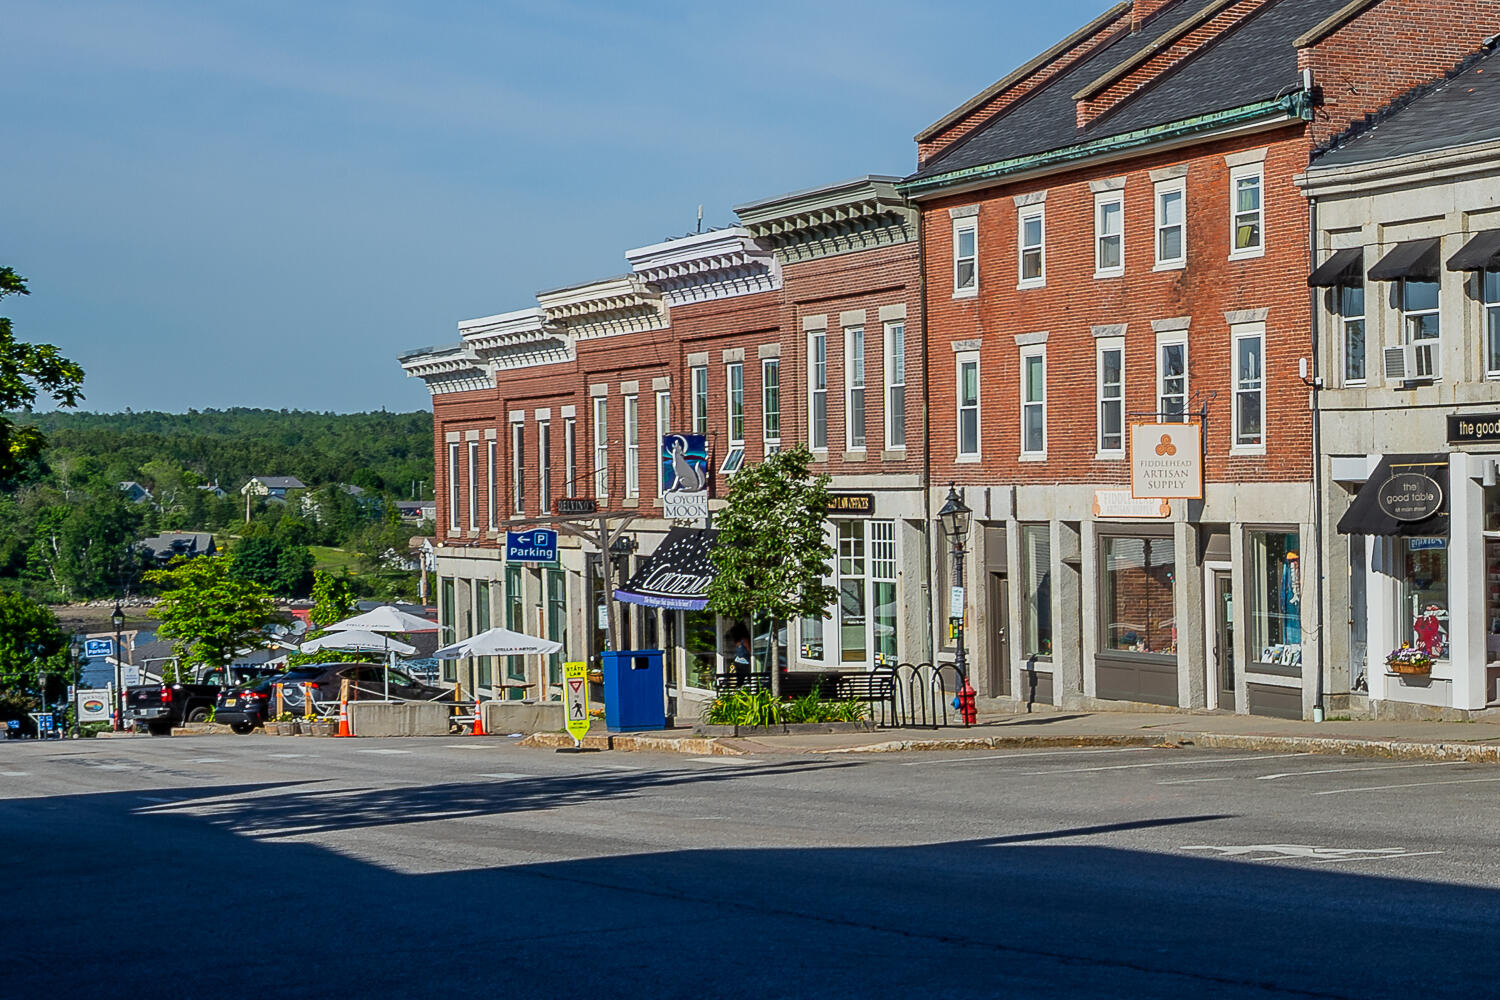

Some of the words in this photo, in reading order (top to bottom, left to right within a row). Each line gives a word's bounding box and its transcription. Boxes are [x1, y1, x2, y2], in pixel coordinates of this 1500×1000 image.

[1459, 420, 1474, 435] the
[1476, 419, 1500, 437] good
[1143, 469, 1189, 478] ARTISAN
[1147, 480, 1186, 489] SUPPLY
[1403, 483, 1417, 491] the
[664, 491, 706, 504] COYOTE
[1386, 494, 1409, 504] good
[1411, 492, 1434, 501] table
[665, 506, 707, 516] MOON
[537, 535, 545, 543] P
[510, 547, 553, 559] Parking
[642, 563, 697, 593] COYOTE
